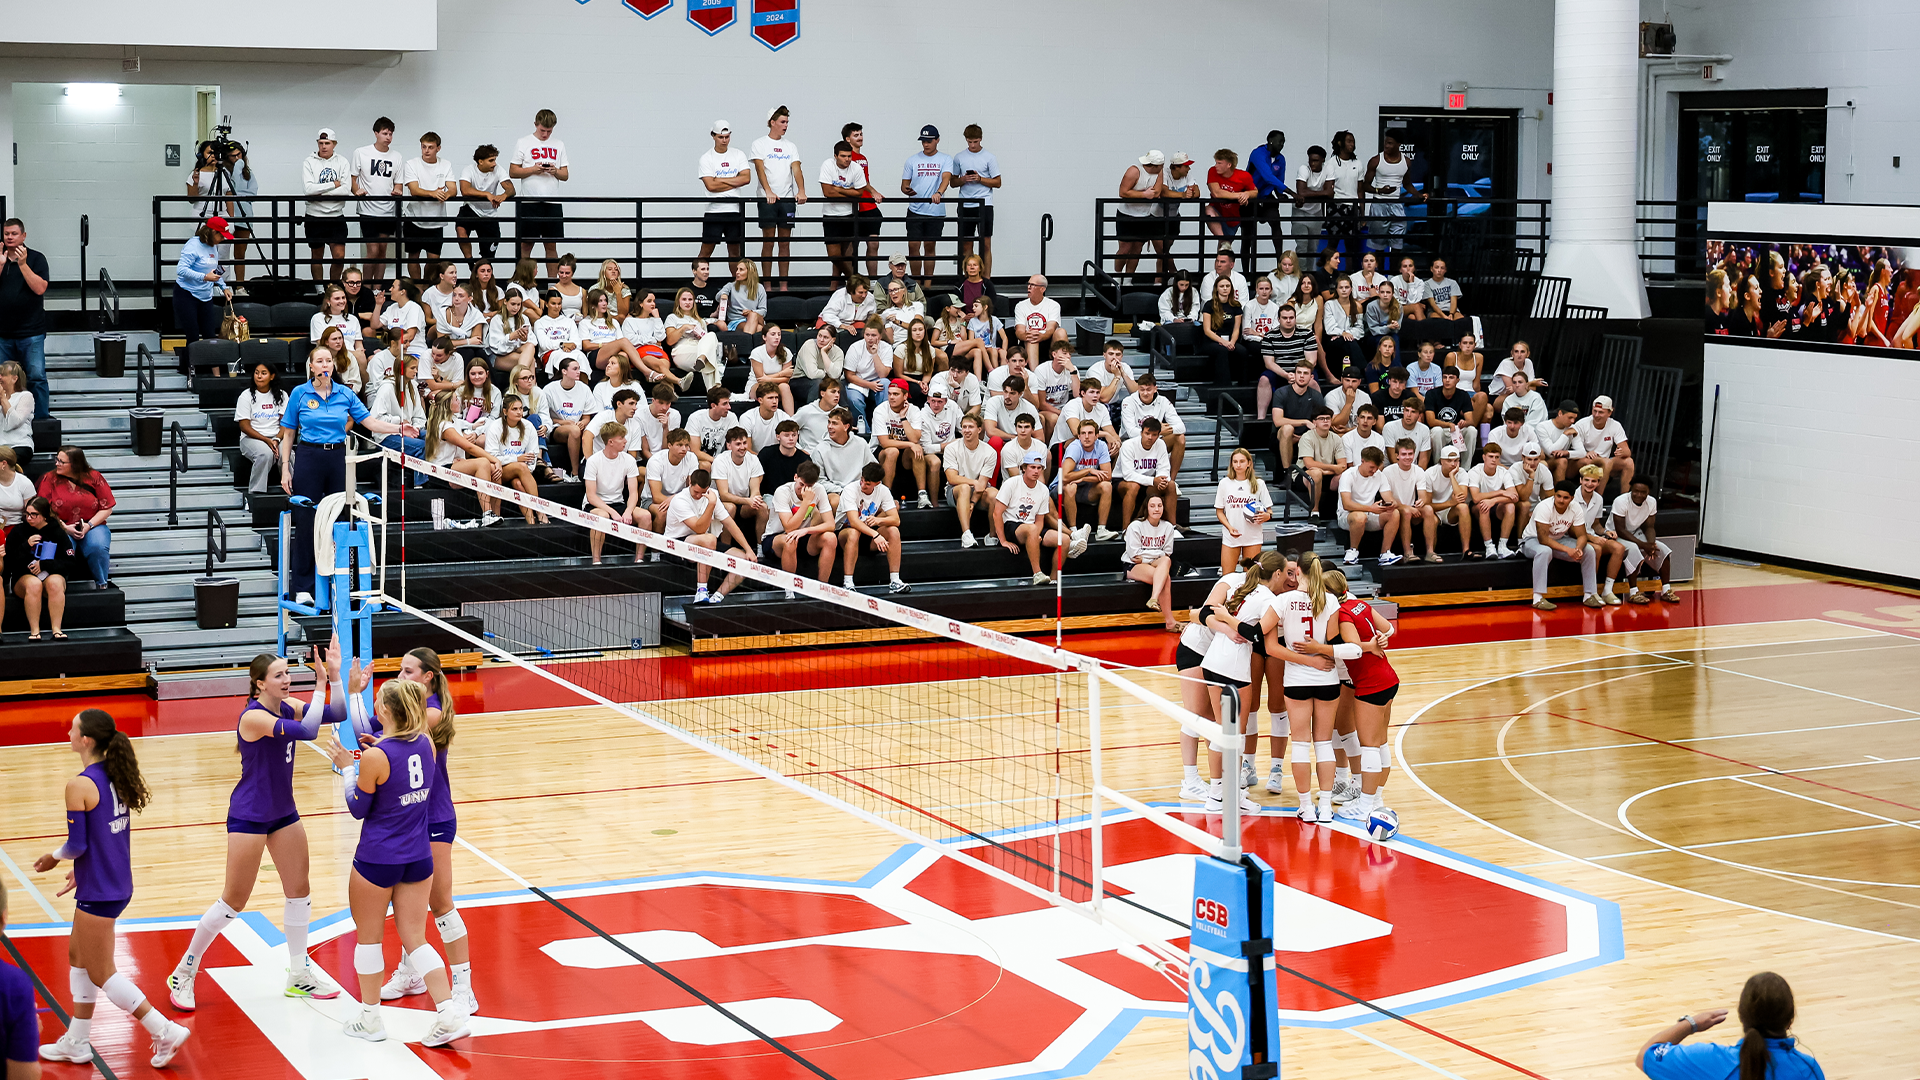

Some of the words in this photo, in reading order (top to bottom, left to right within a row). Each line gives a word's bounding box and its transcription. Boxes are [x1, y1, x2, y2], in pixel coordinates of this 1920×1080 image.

[766, 14, 784, 22] 2024
[1448, 94, 1465, 108] EXIT
[531, 147, 558, 160] SJU
[1708, 146, 1720, 154] EXIT
[1756, 146, 1770, 154] EXIT
[1811, 146, 1825, 154] EXIT
[1706, 154, 1721, 162] ONLY
[1755, 154, 1770, 162] ONLY
[1809, 154, 1825, 162] ONLY
[1046, 384, 1068, 393] DUKE
[1384, 407, 1404, 416] EAGLE
[750, 563, 760, 571] SAINT
[761, 566, 778, 577] BENEDICT
[793, 577, 803, 589] CSB
[820, 584, 830, 593] SAINT
[831, 586, 849, 598] BENEDICT
[896, 606, 908, 615] SAINT
[908, 609, 929, 621] BENEDICT
[948, 622, 961, 635] CSB
[1301, 616, 1313, 639] 3
[981, 630, 994, 639] SAINT
[995, 632, 1018, 646] BENEDICT
[285, 741, 293, 764] 9
[407, 753, 423, 789] 8
[1195, 897, 1228, 928] CSB
[1196, 921, 1227, 938] VOLLEYBALL
